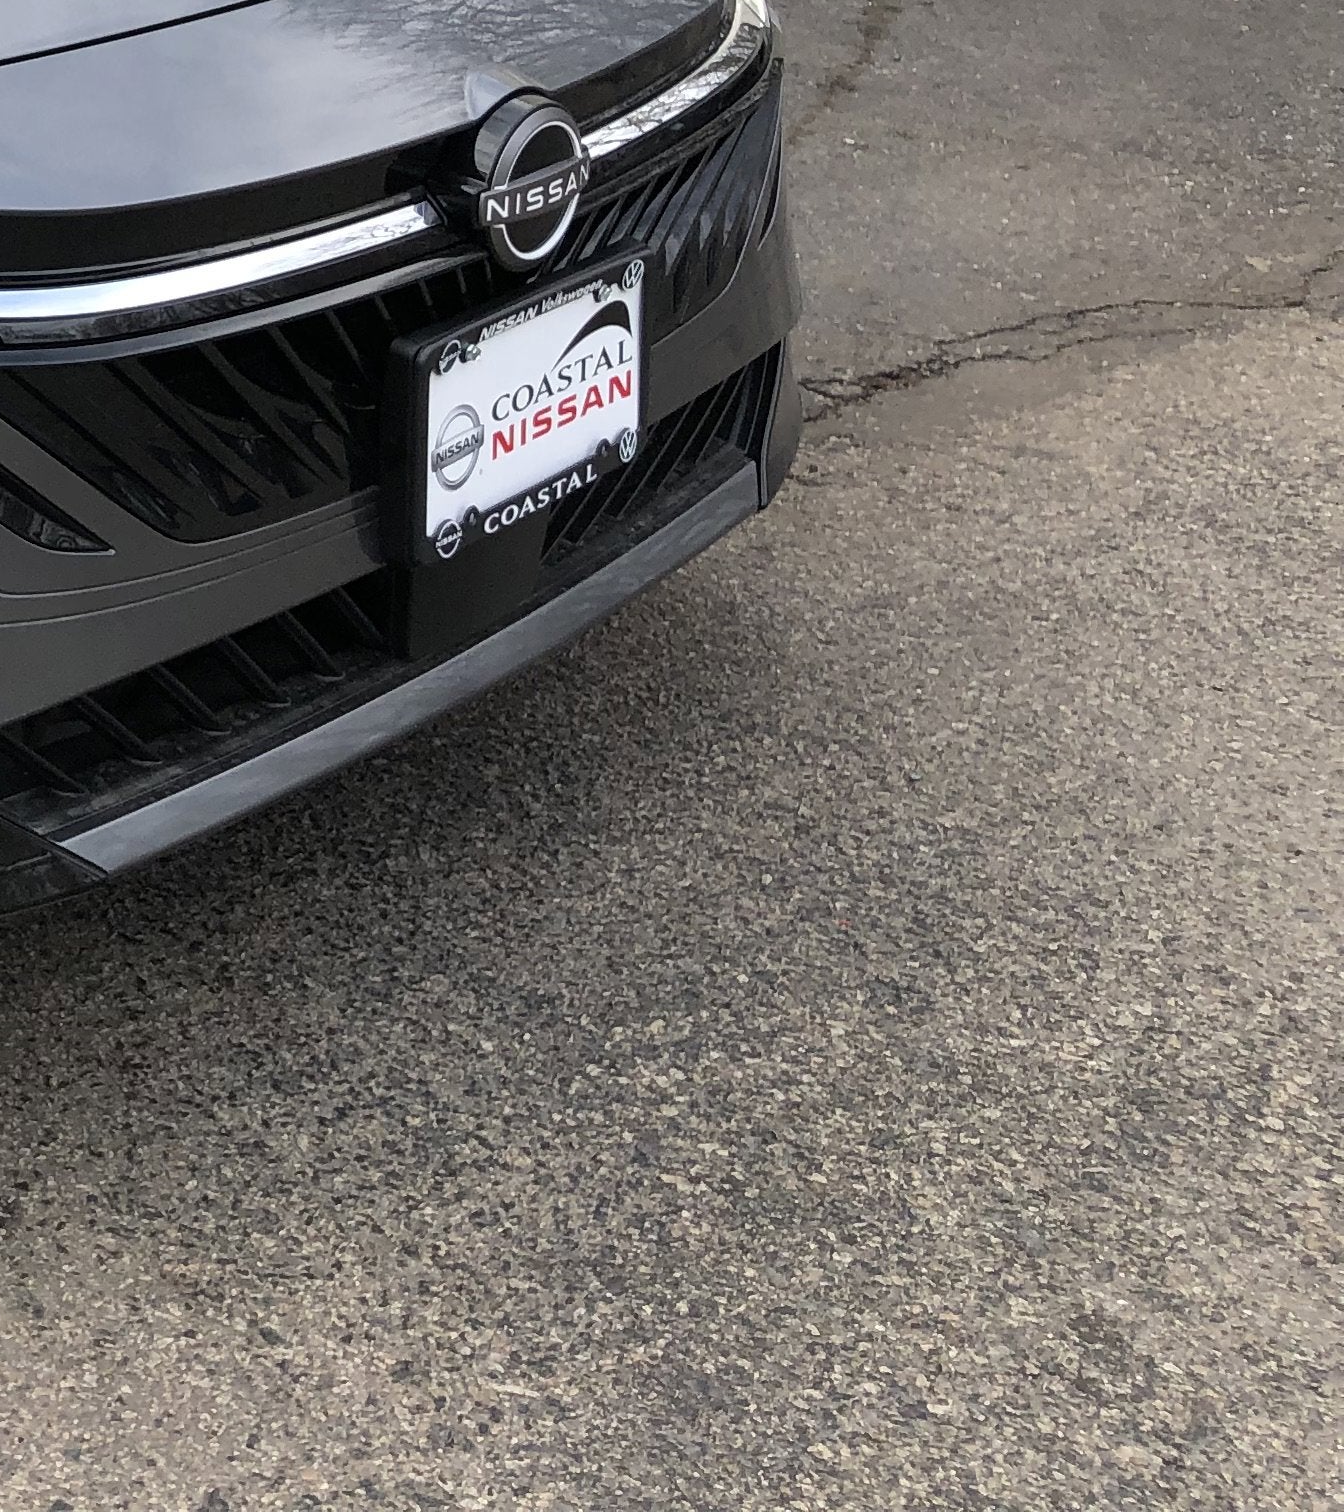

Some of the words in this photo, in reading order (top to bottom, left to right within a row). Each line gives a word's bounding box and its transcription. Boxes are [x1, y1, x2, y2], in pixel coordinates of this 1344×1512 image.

[486, 159, 590, 222] NISSAN
[479, 304, 539, 342] NISSAN
[491, 339, 633, 422] COASTAL
[435, 431, 482, 465] NISSAN
[491, 369, 632, 461] NISSAN
[483, 463, 598, 535] COASTAL
